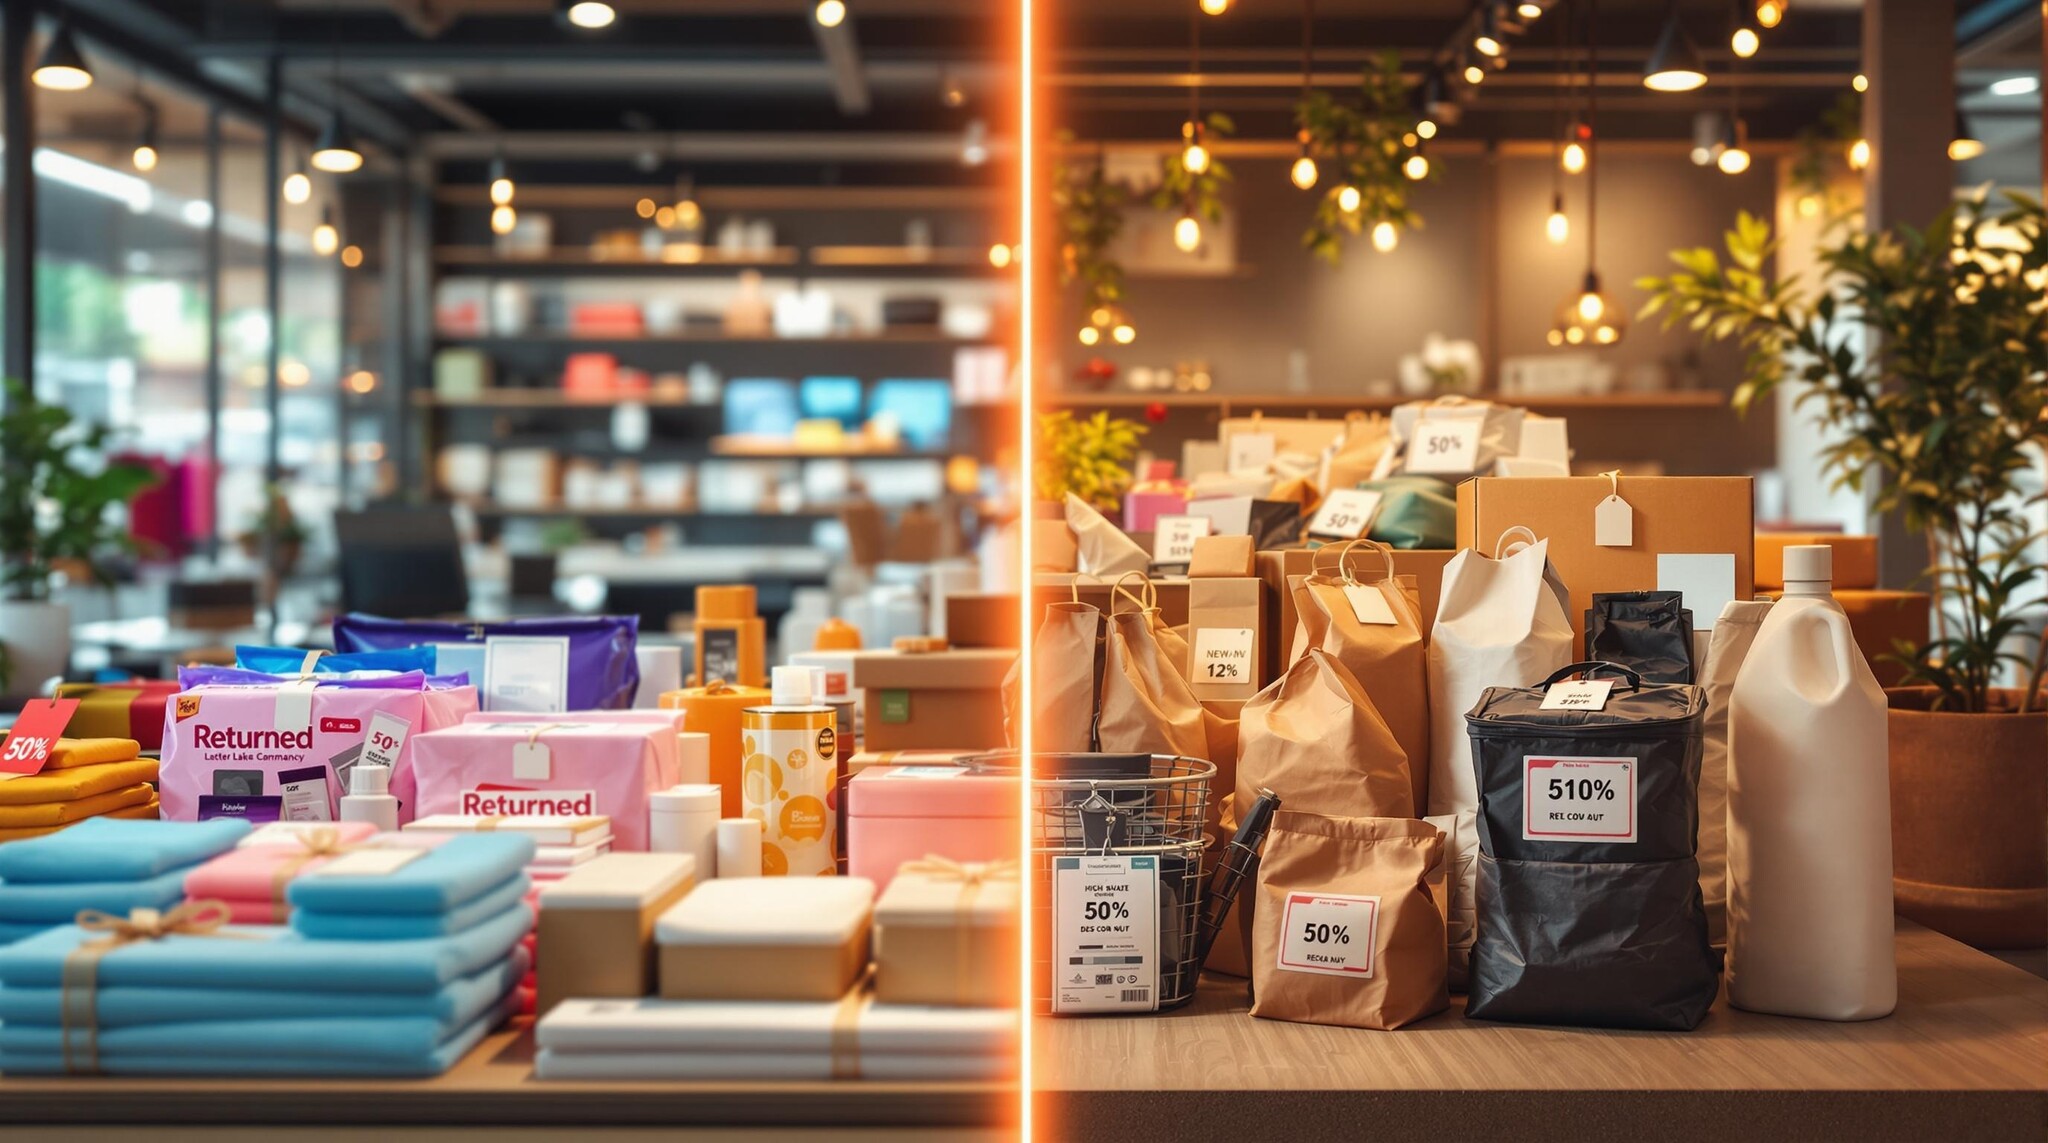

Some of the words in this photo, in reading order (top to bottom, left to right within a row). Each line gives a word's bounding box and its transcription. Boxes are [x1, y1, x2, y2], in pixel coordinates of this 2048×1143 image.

[1427, 436, 1462, 454] 50%
[1207, 663, 1238, 677] 12%
[194, 724, 313, 749] Returned
[3, 736, 50, 760] 50%
[1548, 779, 1615, 800] 510%
[463, 793, 591, 816] Returned
[1084, 901, 1129, 920] 50%
[1303, 923, 1350, 944] 50%
